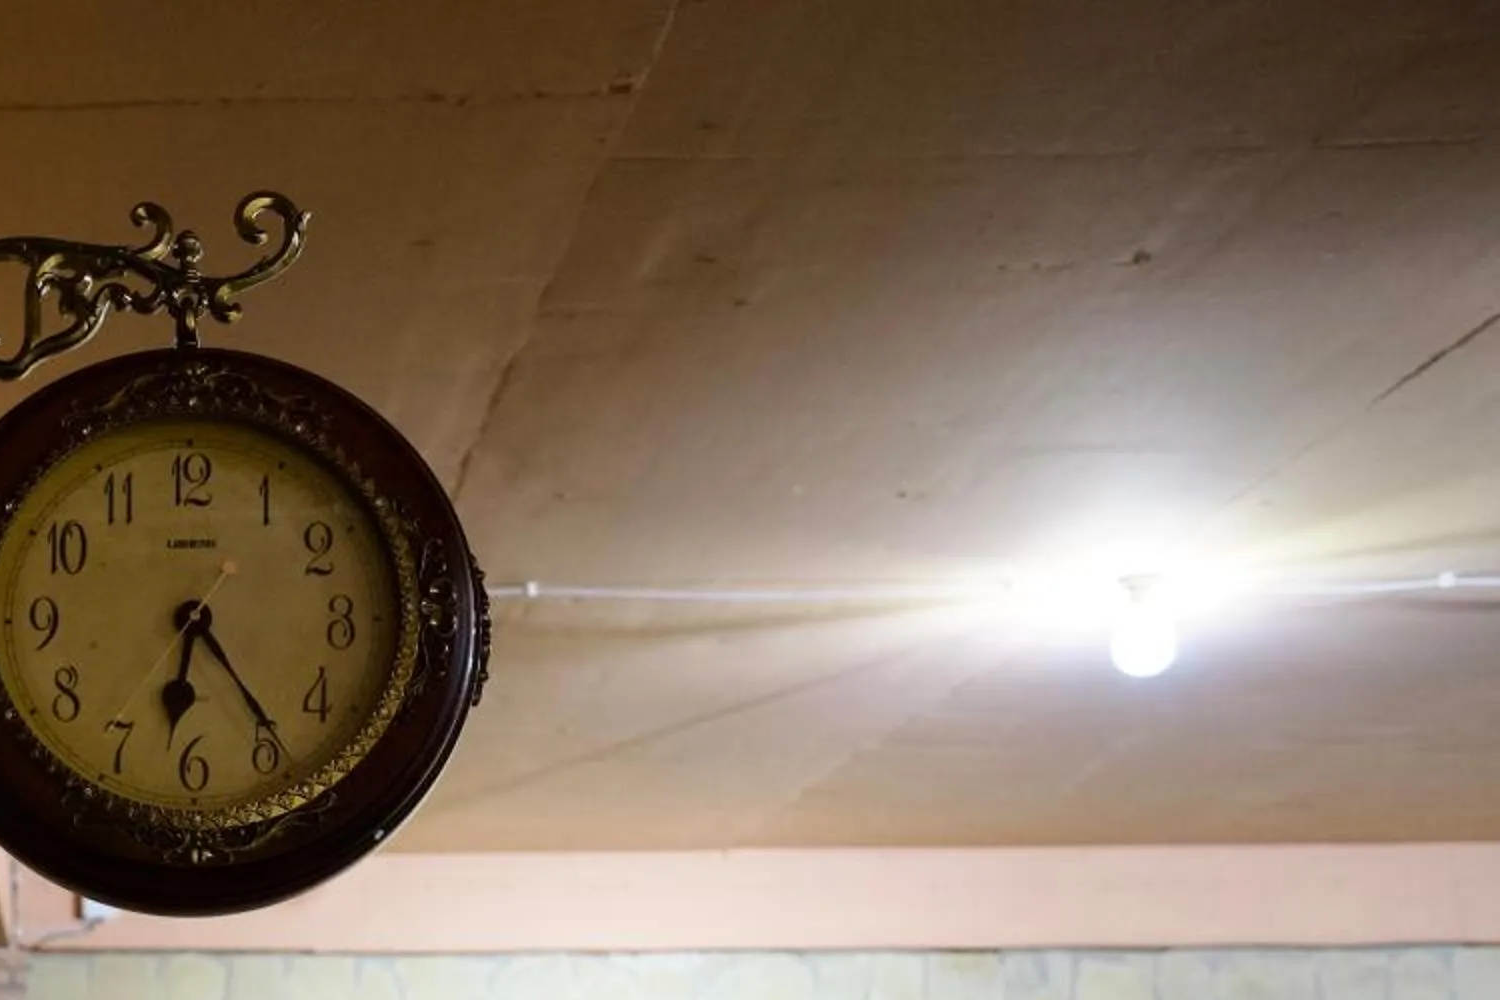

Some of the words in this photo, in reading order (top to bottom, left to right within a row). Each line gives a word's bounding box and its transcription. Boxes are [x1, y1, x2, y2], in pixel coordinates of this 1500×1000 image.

[103, 471, 133, 526] 11
[171, 451, 212, 506] 12
[259, 473, 270, 526] 1
[47, 520, 88, 576] 10
[303, 521, 334, 576] 2
[29, 596, 60, 651] 9
[326, 594, 356, 650] 3
[51, 665, 80, 723] 8
[302, 666, 333, 724] 4
[104, 720, 134, 775] 7
[179, 735, 210, 793] 6
[252, 719, 279, 775] 5
